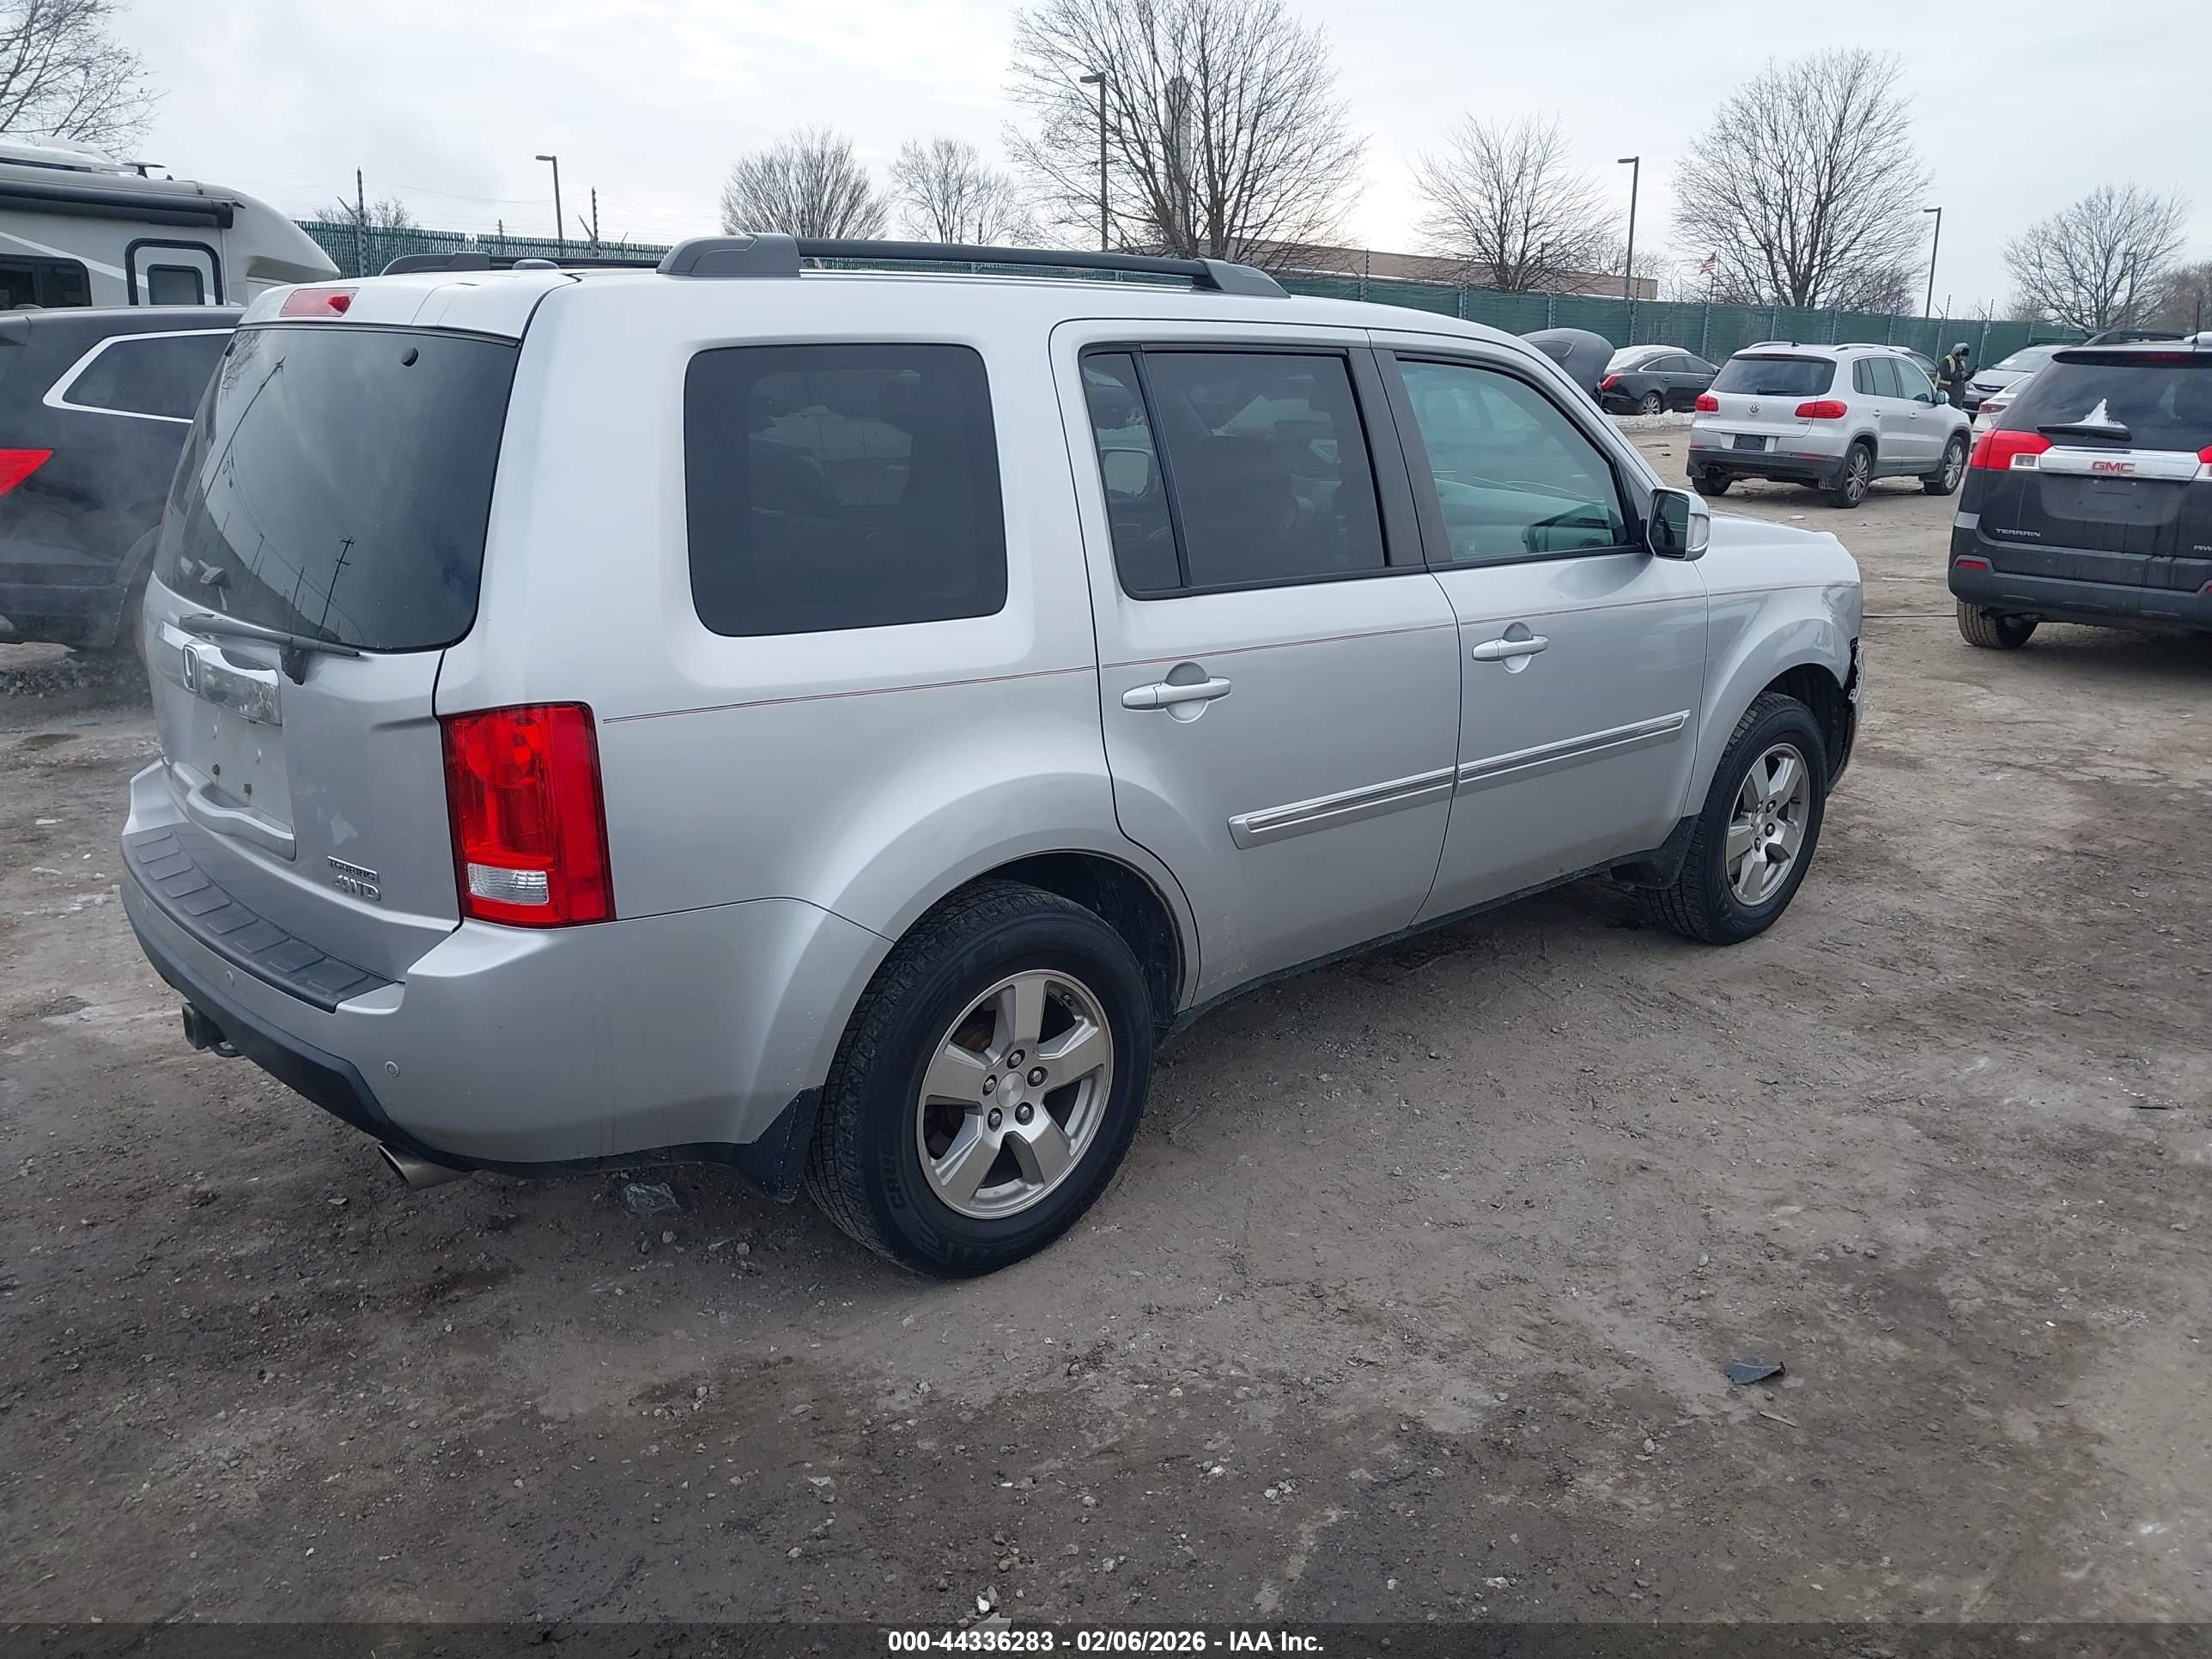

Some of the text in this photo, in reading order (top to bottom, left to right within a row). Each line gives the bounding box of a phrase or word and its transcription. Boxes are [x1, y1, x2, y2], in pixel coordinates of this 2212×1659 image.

[2092, 460, 2136, 473] GMC
[1995, 527, 2041, 538] TERRAIN
[328, 859, 376, 882] TOURING
[333, 874, 382, 901] 4WD
